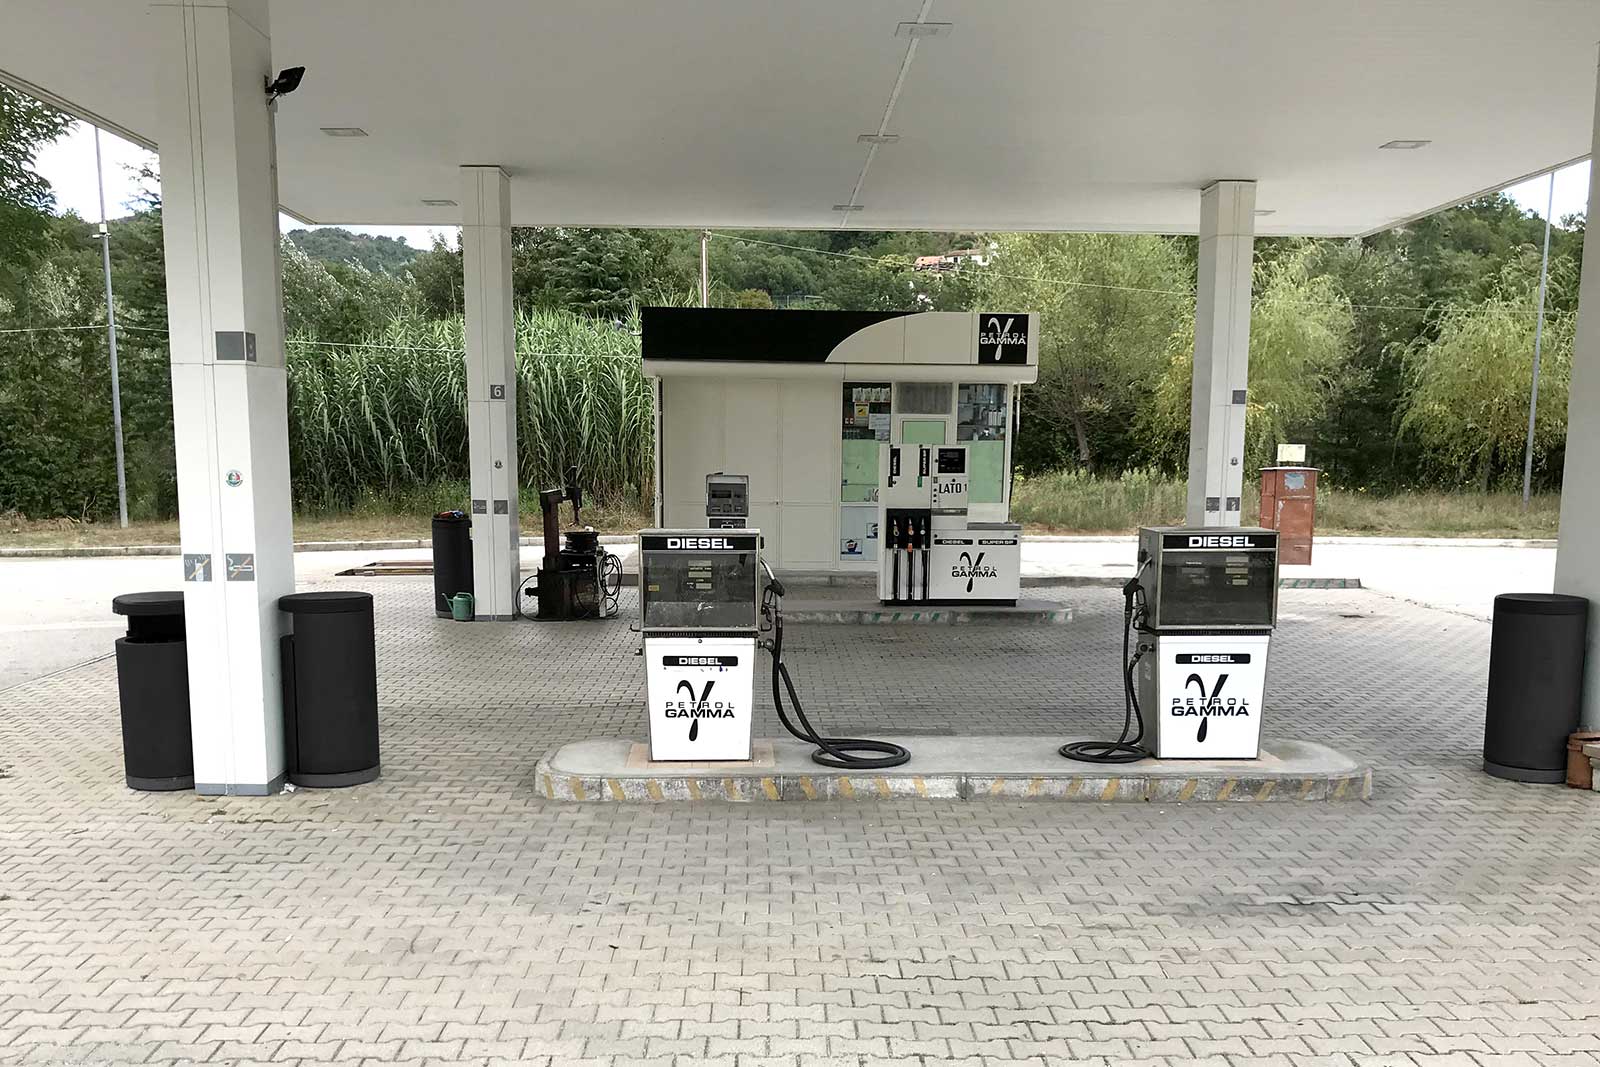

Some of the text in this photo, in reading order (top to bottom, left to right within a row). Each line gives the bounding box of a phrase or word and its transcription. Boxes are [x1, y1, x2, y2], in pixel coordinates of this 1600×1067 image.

[980, 337, 1026, 345] GAMMA
[494, 386, 501, 397] 6
[939, 483, 961, 493] LATO
[667, 538, 734, 549] DIESEL
[1189, 536, 1255, 547] DIESEL
[678, 657, 722, 665] DIESEL
[1191, 655, 1235, 663] DIESEL
[665, 701, 735, 709] PETROL
[1172, 698, 1249, 706] PETROL
[665, 709, 735, 718] GAMMA
[1171, 706, 1249, 717] GAMMA
